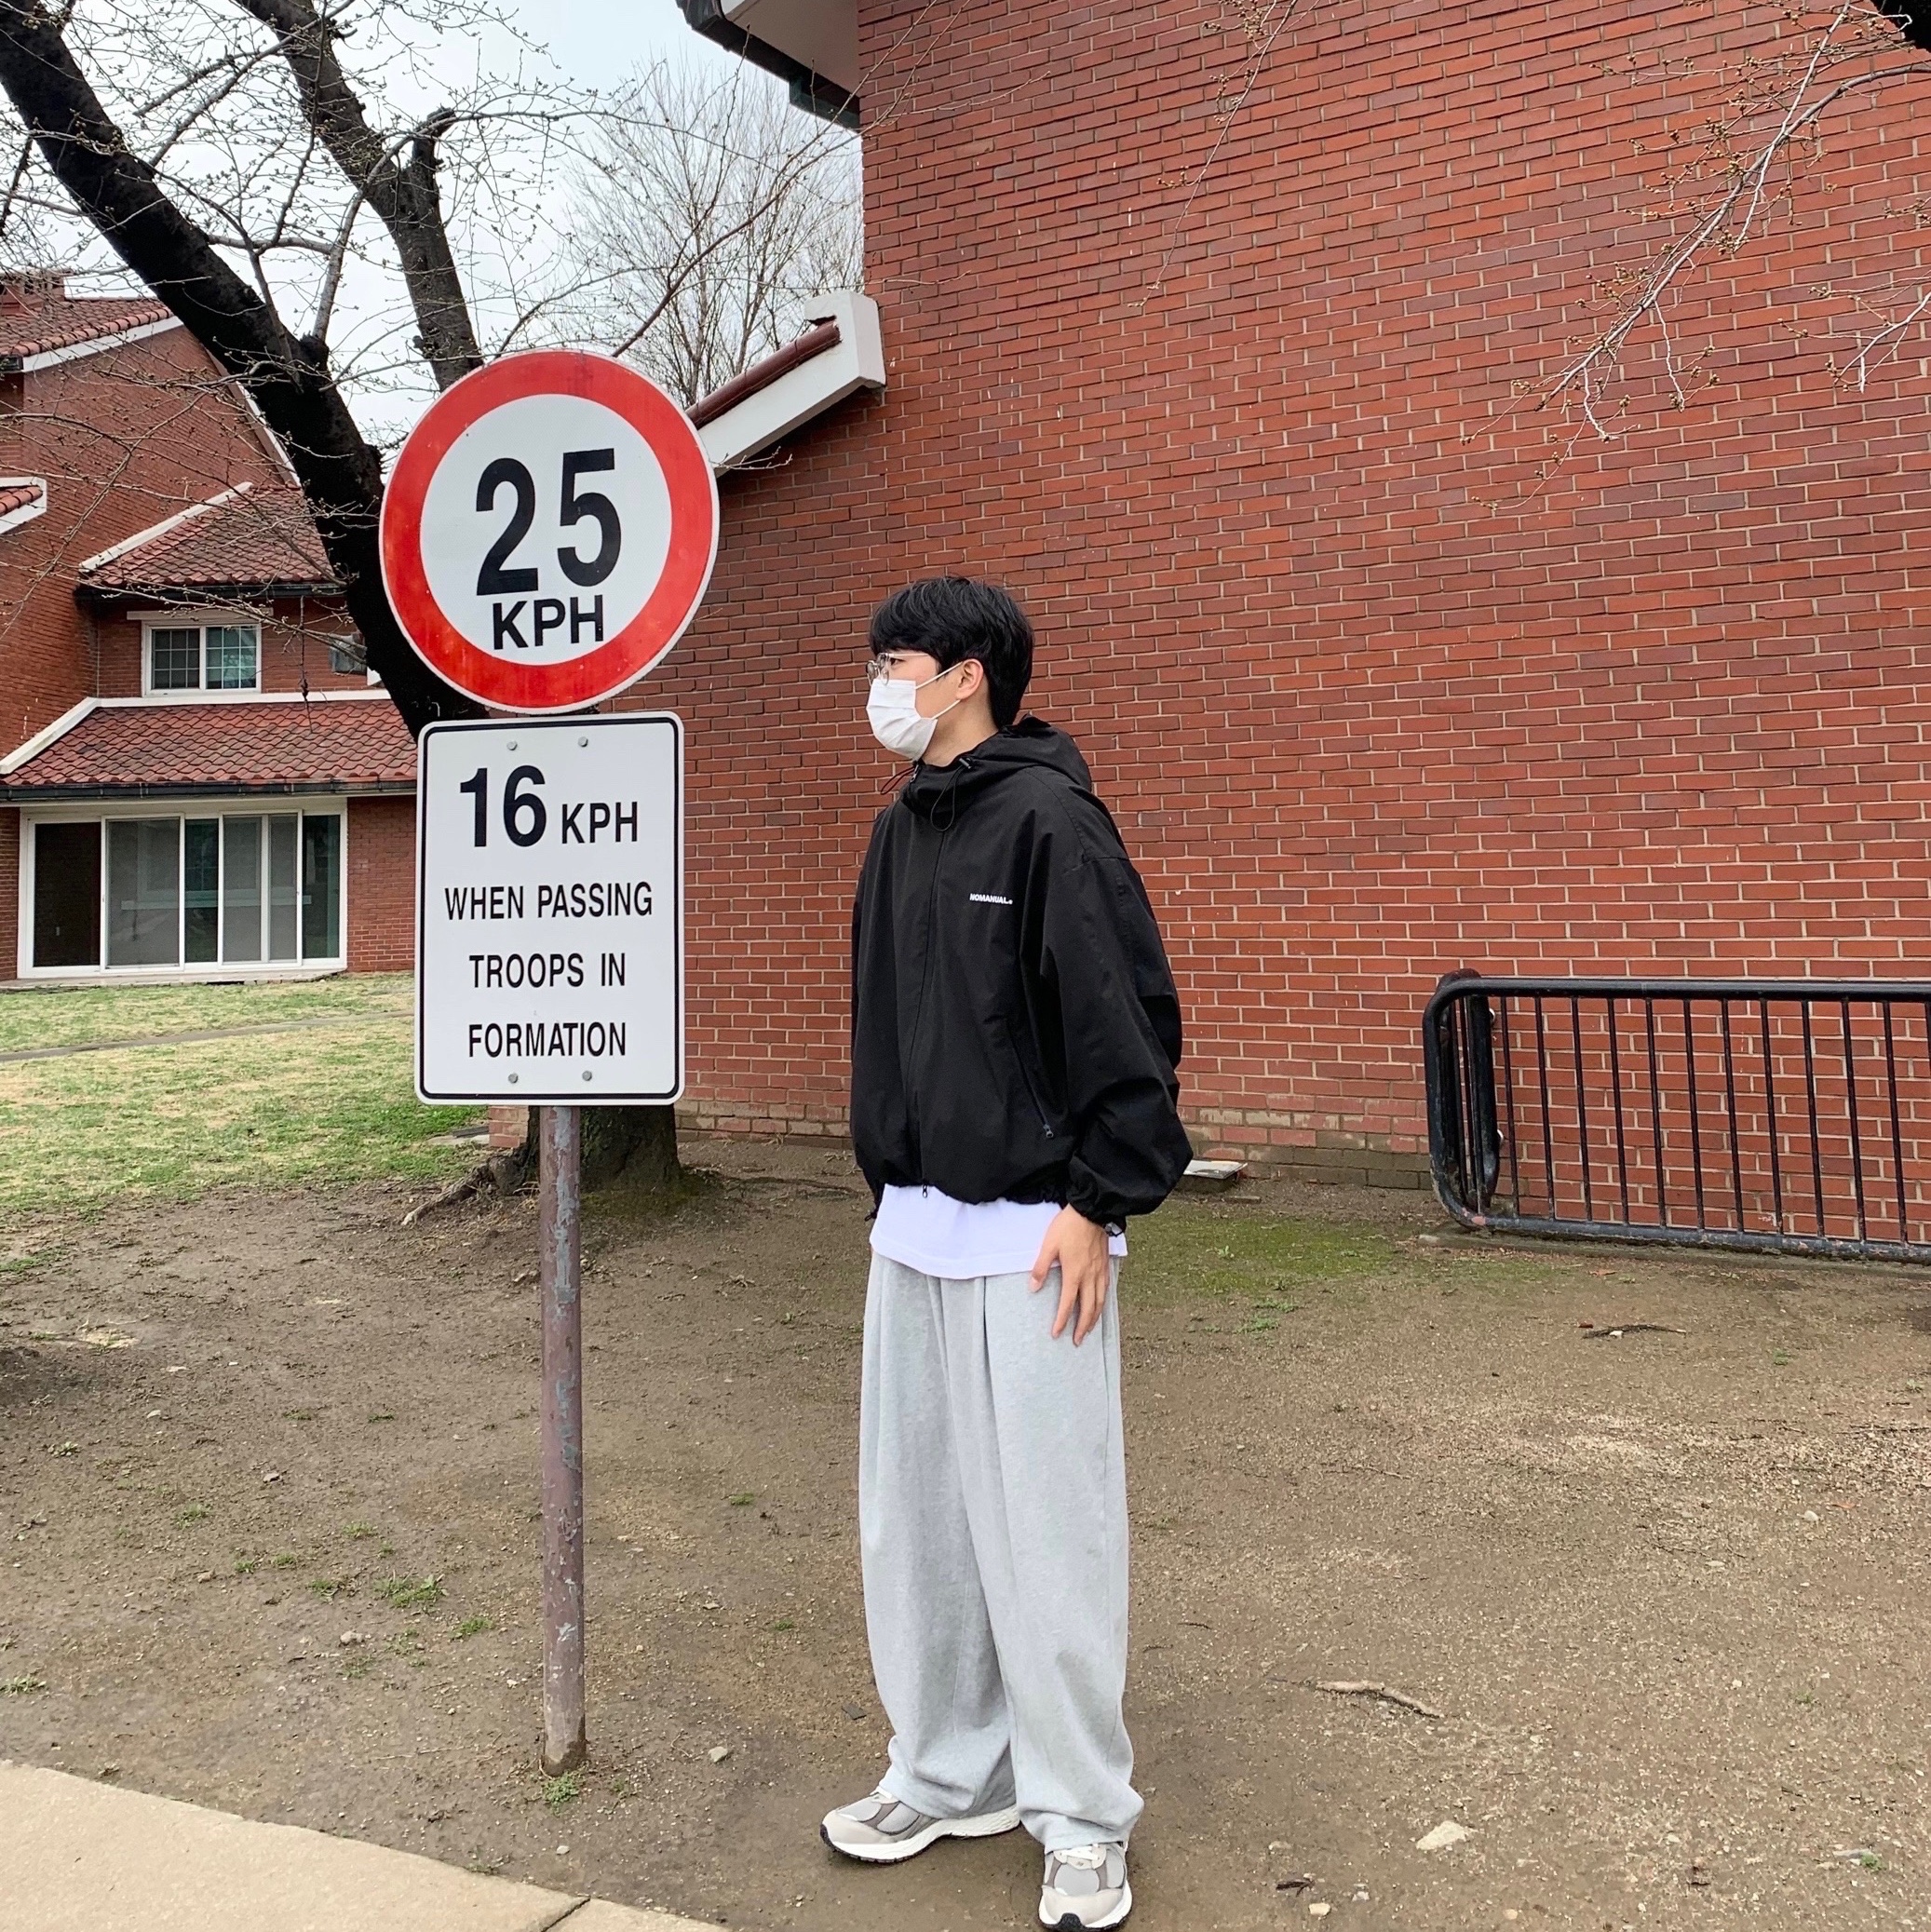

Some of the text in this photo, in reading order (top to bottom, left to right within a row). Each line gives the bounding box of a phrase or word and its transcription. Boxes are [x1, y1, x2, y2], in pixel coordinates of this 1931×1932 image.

[476, 448, 621, 596] 25
[493, 594, 604, 650] KPH
[460, 765, 639, 847] 16 KPH
[445, 882, 653, 920] WHEN PASSING
[469, 952, 626, 988] TROOPS IN
[468, 1022, 627, 1058] FORMATION
